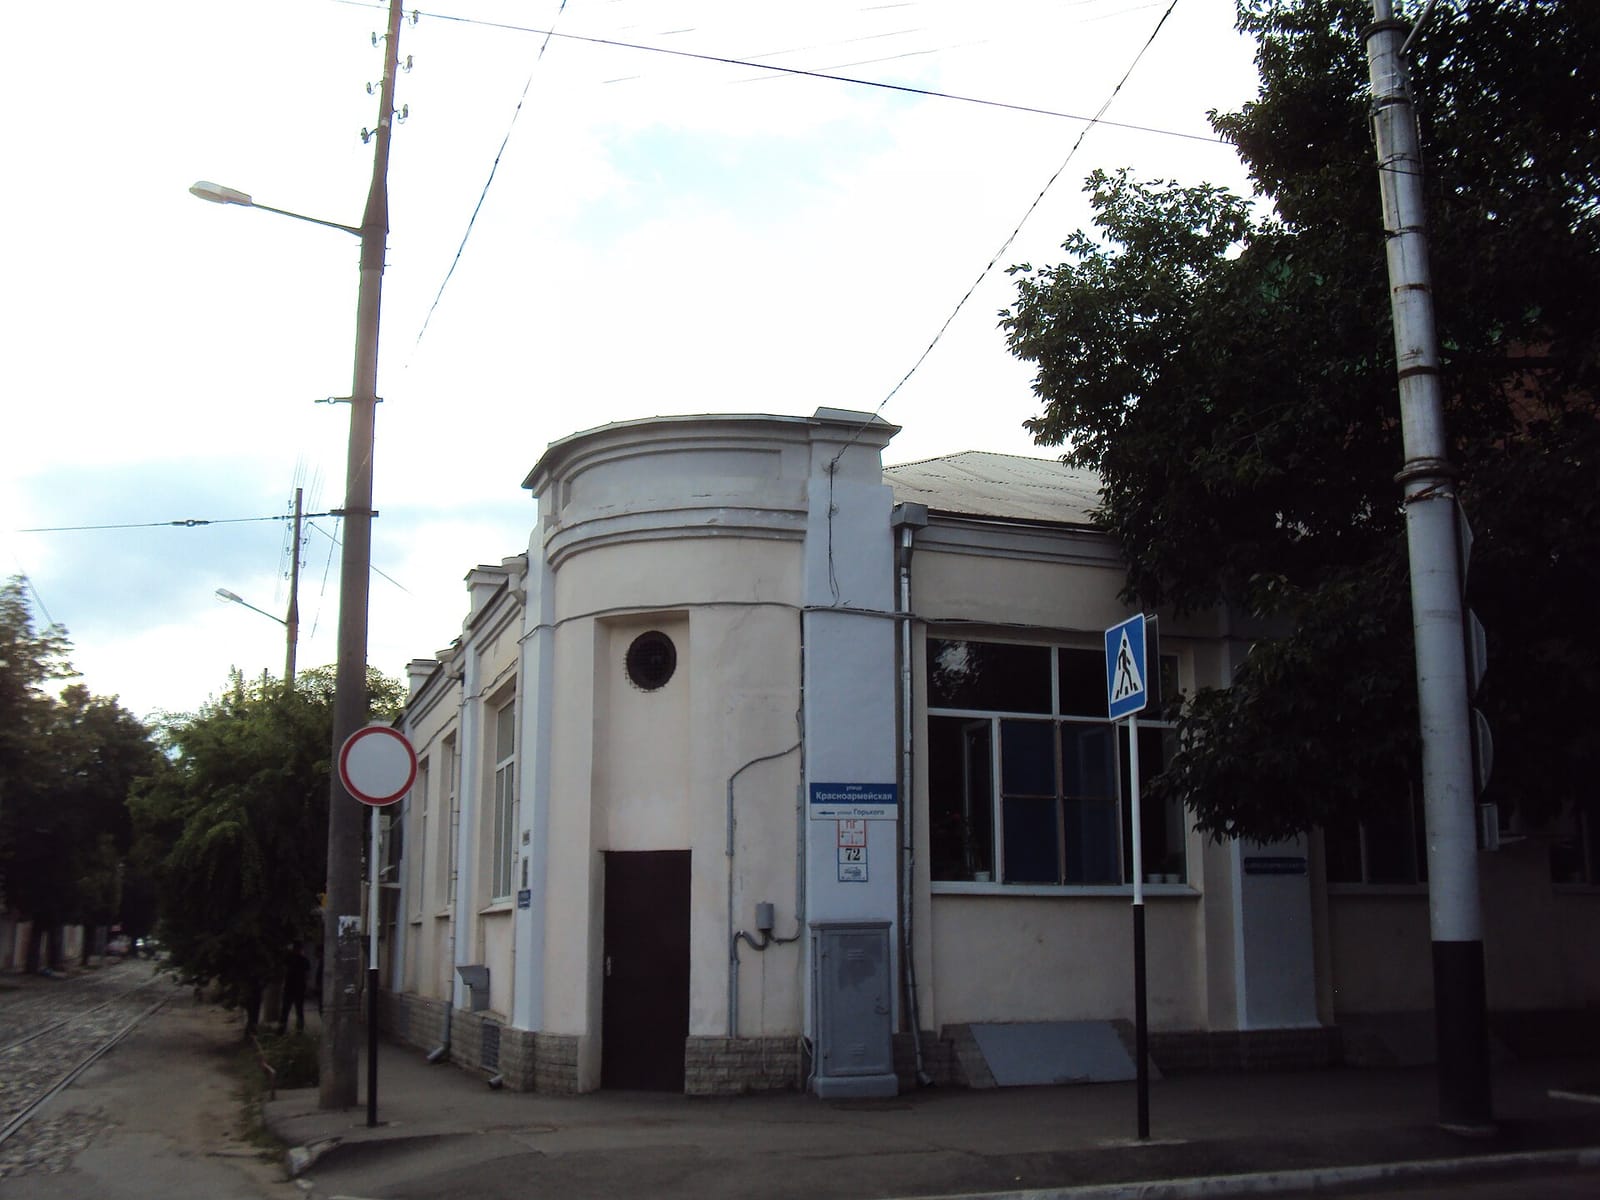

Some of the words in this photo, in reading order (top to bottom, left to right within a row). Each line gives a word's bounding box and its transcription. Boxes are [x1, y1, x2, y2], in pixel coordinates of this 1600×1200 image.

[815, 791, 893, 801] Красноармейская
[853, 808, 885, 816] Горького
[845, 848, 861, 861] 72
